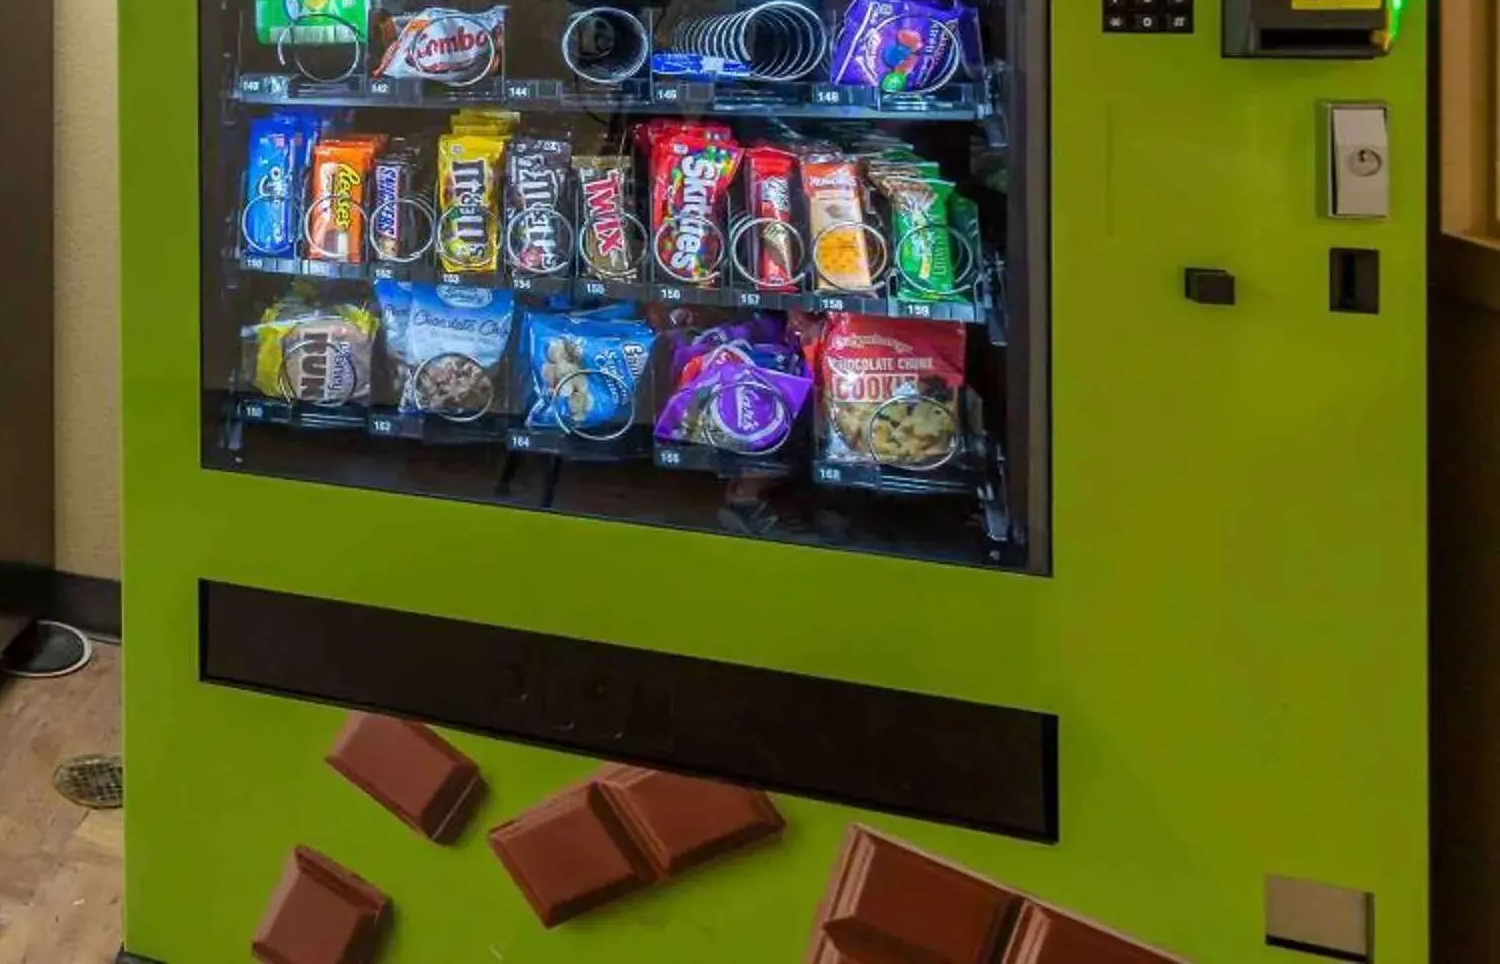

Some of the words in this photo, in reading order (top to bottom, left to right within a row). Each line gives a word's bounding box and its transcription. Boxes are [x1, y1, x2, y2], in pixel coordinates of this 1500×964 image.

[1142, 16, 1153, 28] 0
[508, 87, 528, 98] 144
[377, 166, 398, 237] SNICKERS
[583, 169, 626, 256] TWIX
[671, 155, 717, 270] Skittles
